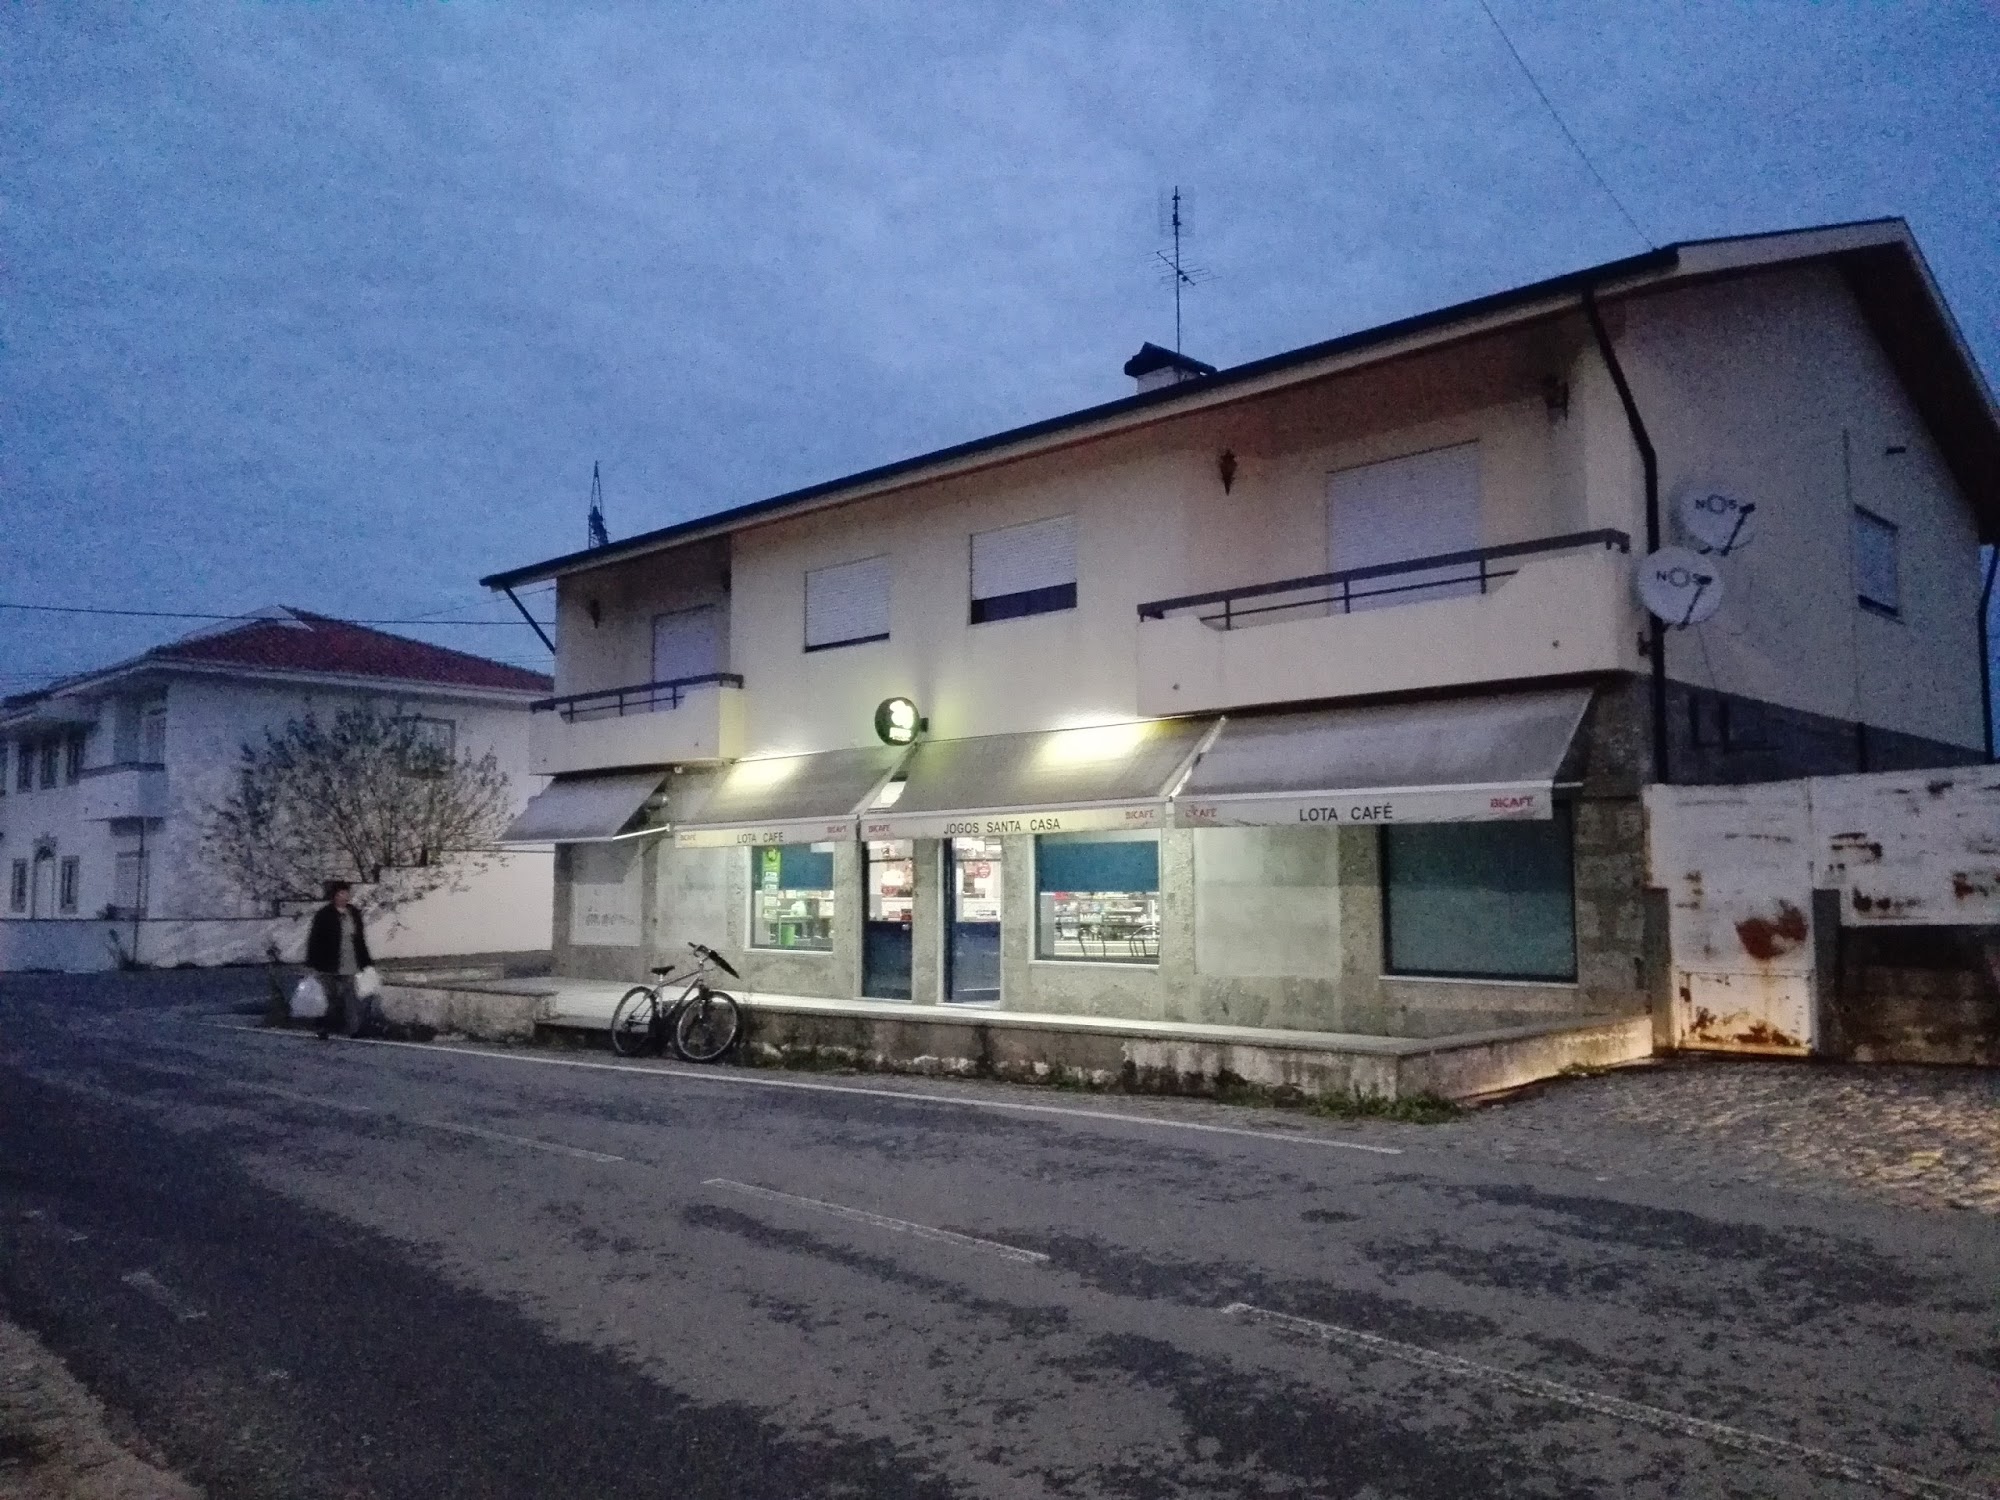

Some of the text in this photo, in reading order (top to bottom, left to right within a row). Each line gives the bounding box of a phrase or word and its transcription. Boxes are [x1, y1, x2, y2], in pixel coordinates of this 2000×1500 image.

[1695, 494, 1737, 515] NOS
[1299, 802, 1393, 822] LOTA CAFÉ
[943, 818, 1061, 835] JOGOS SANTA CASA
[736, 833, 756, 844] LOTA
